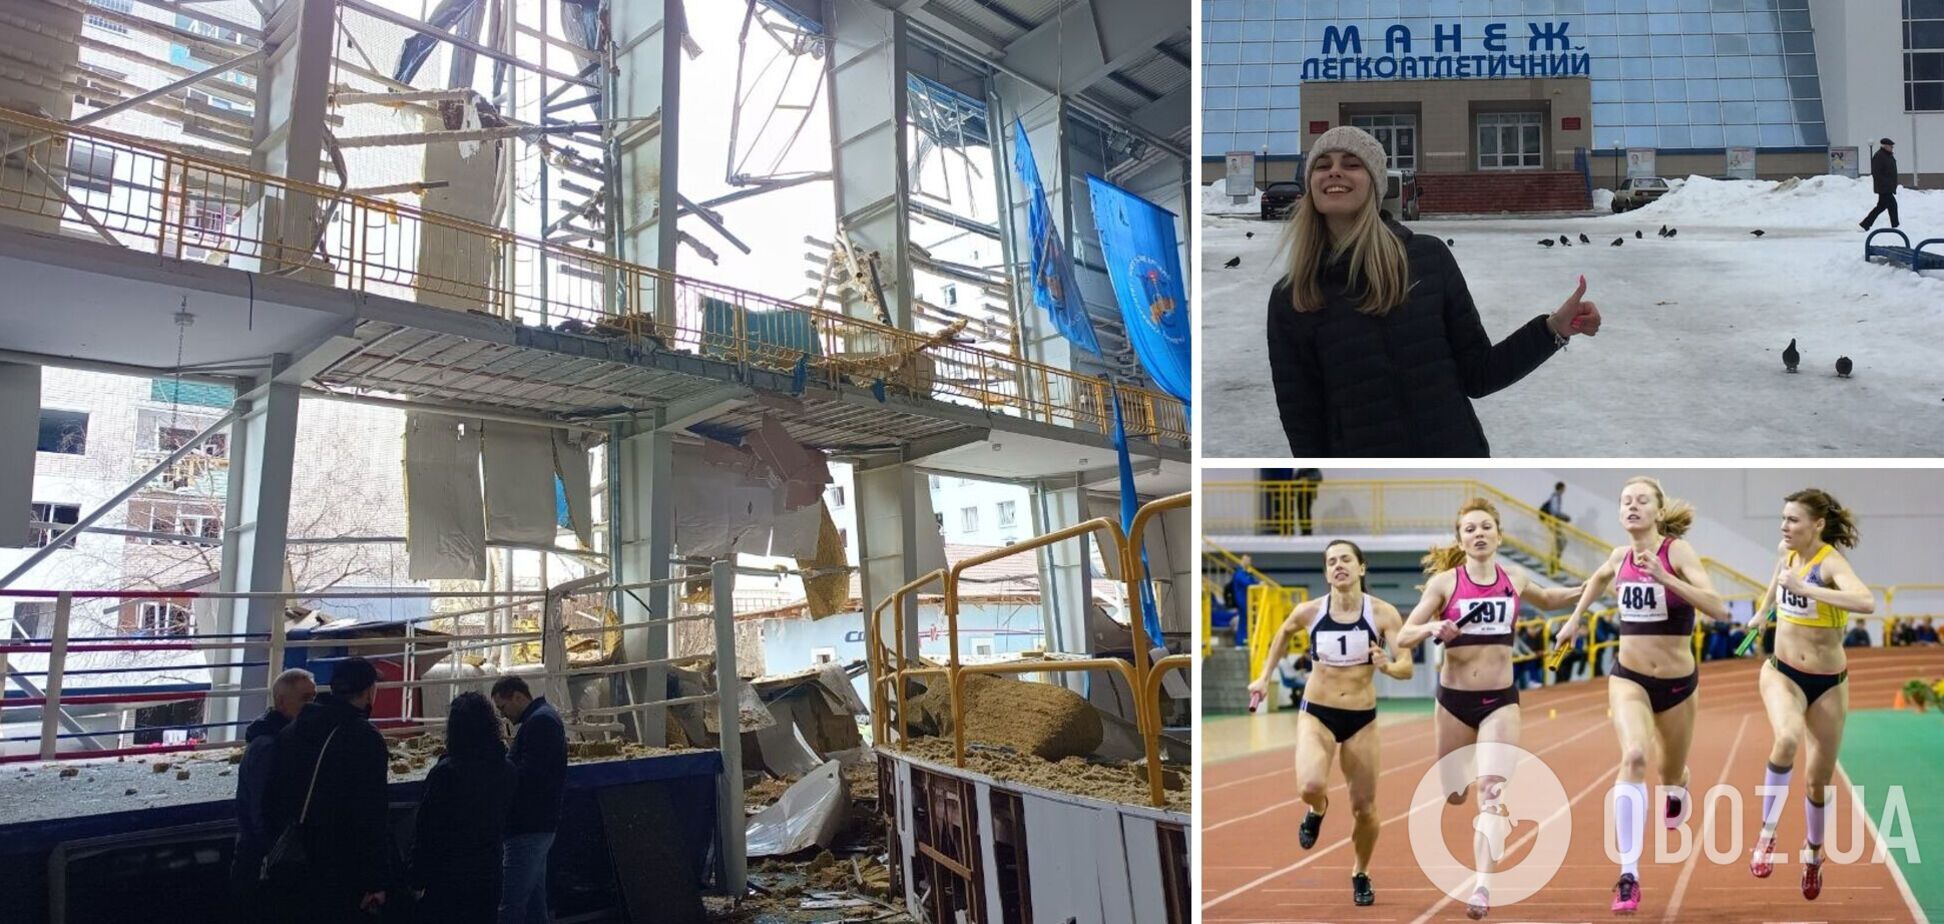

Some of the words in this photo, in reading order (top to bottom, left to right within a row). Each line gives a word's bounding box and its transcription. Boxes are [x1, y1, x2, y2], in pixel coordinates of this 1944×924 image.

[1321, 22, 1571, 54] МАНЕЖ
[1300, 46, 1591, 80] ЛЕГКОАТЛЕТИЧНИЙ
[1621, 586, 1657, 610] 484
[1336, 634, 1348, 656] 1
